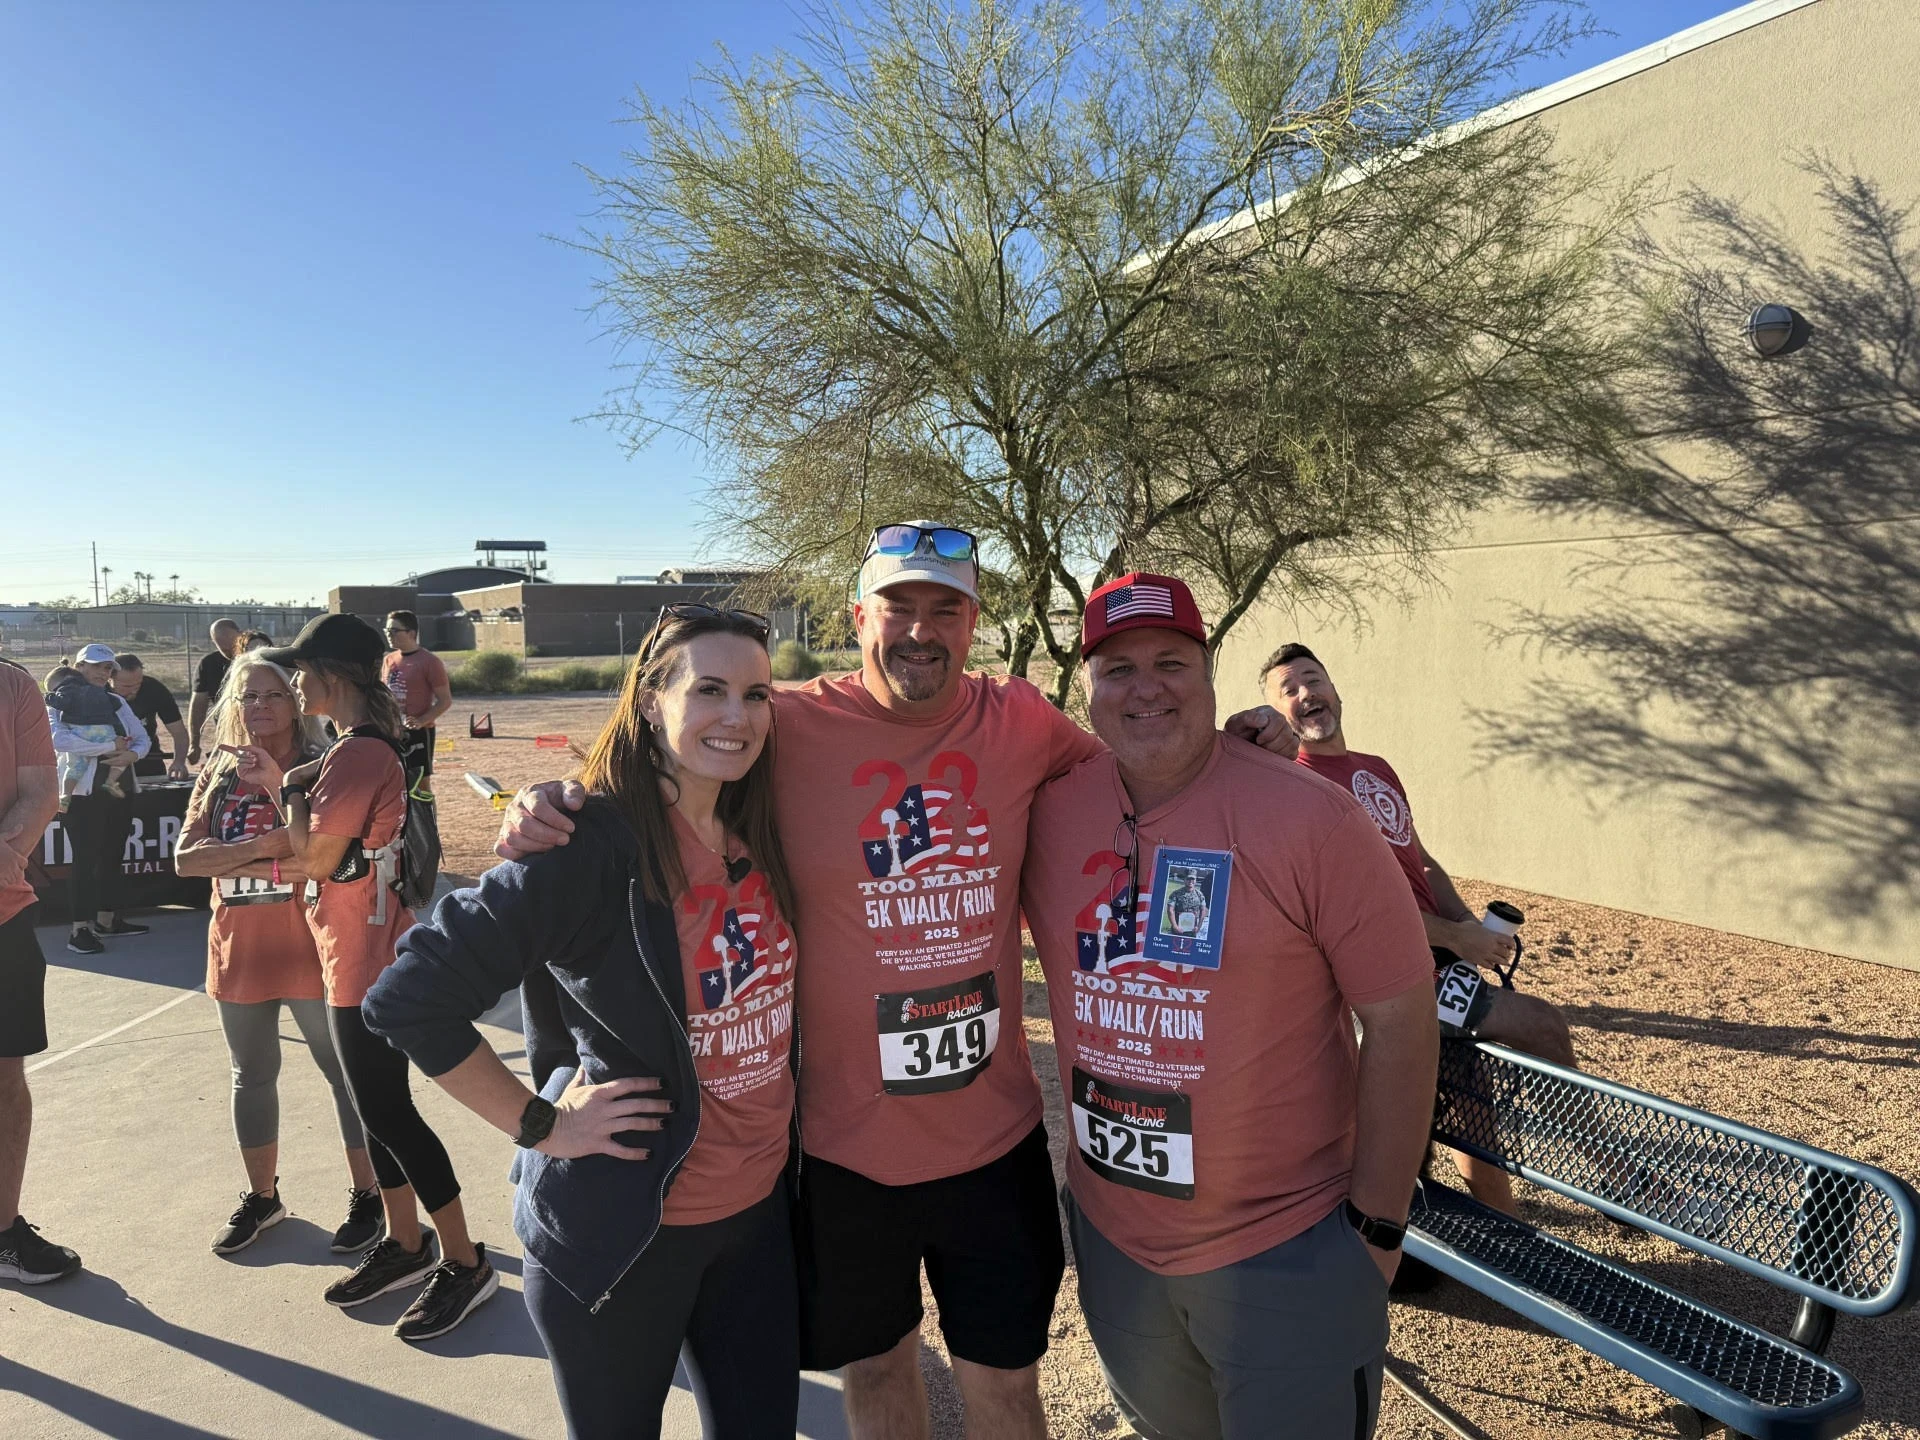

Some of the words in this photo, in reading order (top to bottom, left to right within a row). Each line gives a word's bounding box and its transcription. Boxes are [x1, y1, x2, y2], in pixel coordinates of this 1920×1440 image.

[858, 879, 916, 896] TOO
[922, 866, 1001, 890] MANY
[866, 900, 893, 929] 5K
[897, 884, 996, 926] WALK/RUN
[925, 927, 959, 940] 2025
[926, 942, 962, 953] ESTIMATED
[898, 962, 931, 972] WALKING
[942, 956, 968, 966] CHANGE
[1072, 970, 1117, 994] TOO
[1121, 981, 1211, 1004] MANY
[1439, 964, 1480, 1013] 529
[687, 1007, 740, 1028] TOO
[744, 978, 793, 1016] MANY
[946, 1003, 982, 1021] RACING
[1074, 991, 1093, 1024] 5K
[1098, 997, 1204, 1041] WALK/RUN
[689, 1031, 715, 1057] 5K
[903, 1018, 986, 1077] 349
[1117, 1038, 1152, 1055] 2025
[737, 1050, 769, 1068] 2025
[1077, 1044, 1093, 1055] EVERY
[1117, 1056, 1155, 1068] ESTIMATED
[1165, 1064, 1206, 1072] VETERANS
[1080, 1053, 1089, 1061] DIE
[1088, 1056, 1097, 1064] BY
[1124, 1065, 1147, 1075] WE'RE
[1147, 1070, 1183, 1079] RUNNING
[1091, 1064, 1120, 1077] WALKING
[1131, 1074, 1161, 1085] CHANGE
[1122, 1113, 1165, 1128] RACING
[1087, 1113, 1169, 1178] 525
